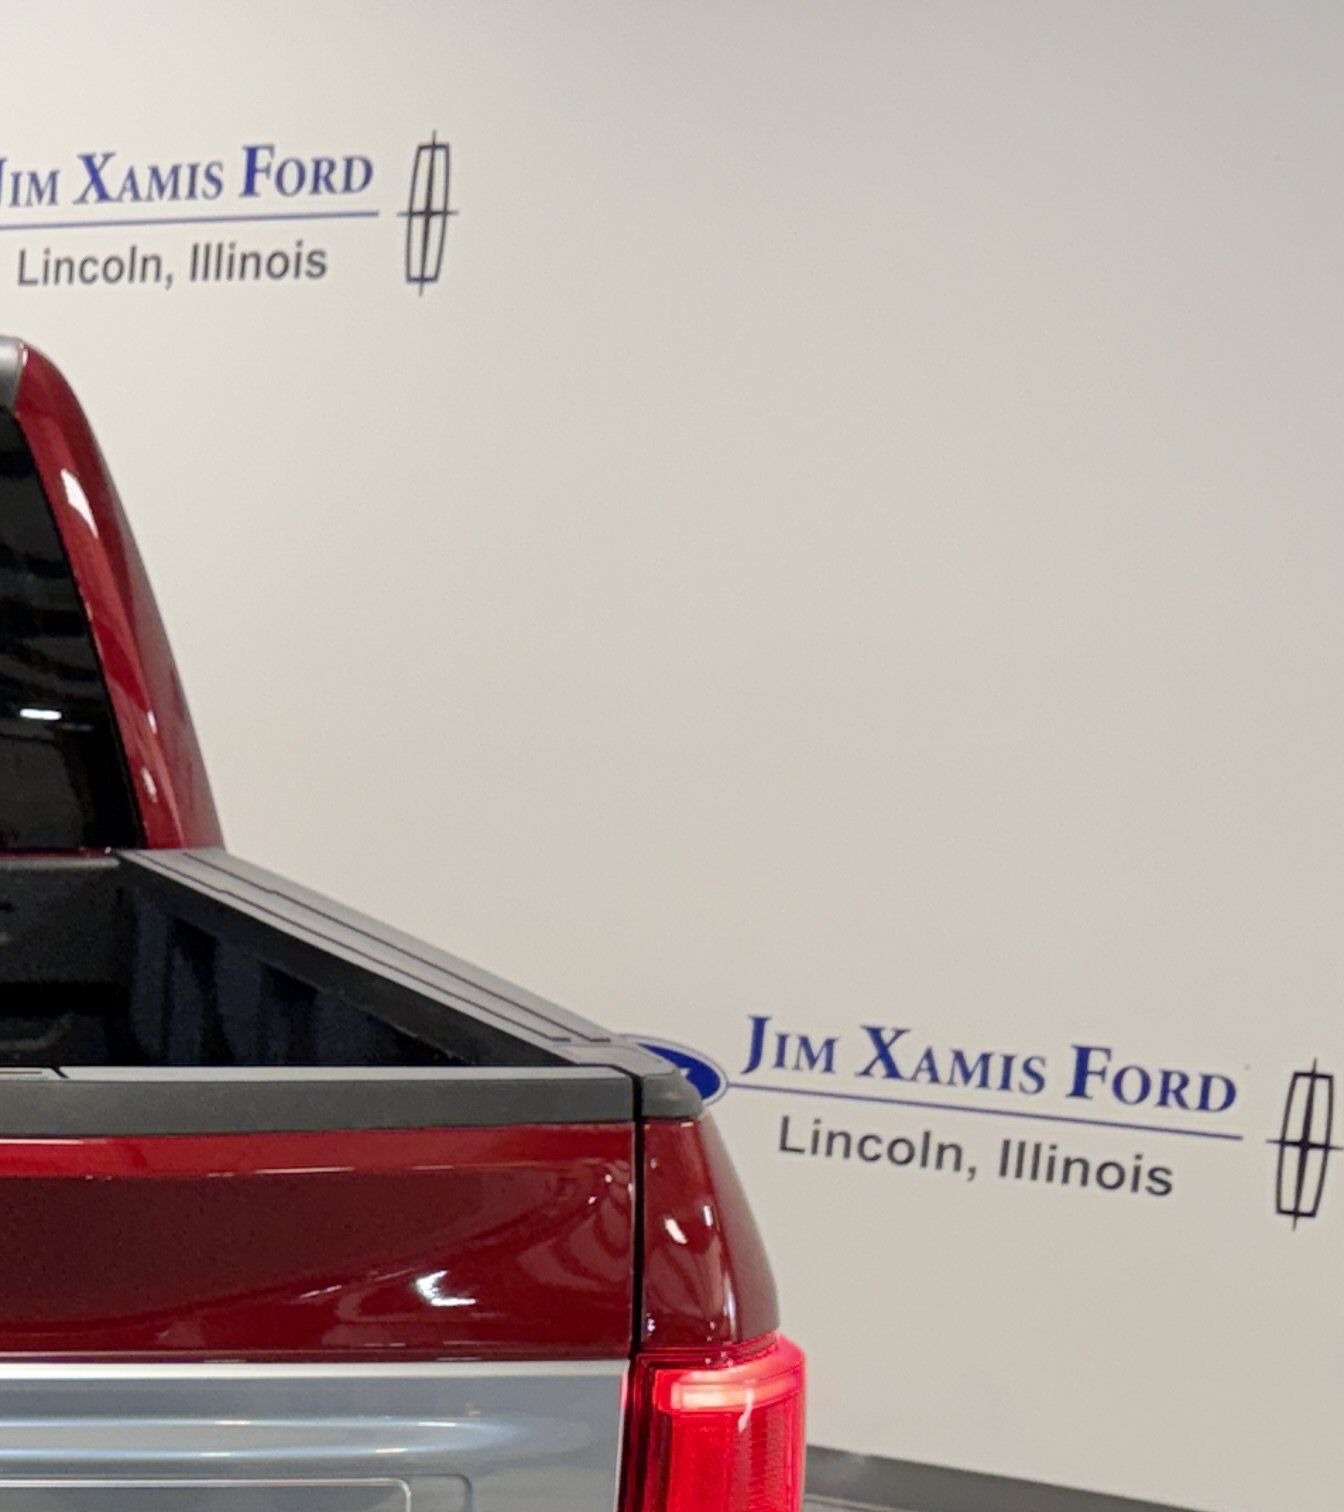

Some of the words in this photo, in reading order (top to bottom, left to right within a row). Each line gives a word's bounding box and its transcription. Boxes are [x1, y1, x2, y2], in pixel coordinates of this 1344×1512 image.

[73, 151, 224, 203] XAMIS
[239, 143, 374, 198] FORD
[17, 247, 175, 288] Lincoln,
[190, 240, 328, 282] Illinois
[740, 1015, 839, 1076] JIM
[853, 1024, 1048, 1095] XAMIS
[1066, 1044, 1238, 1114] FORD
[778, 1115, 977, 1181] Lincoln,
[999, 1139, 1173, 1197] Illinois
